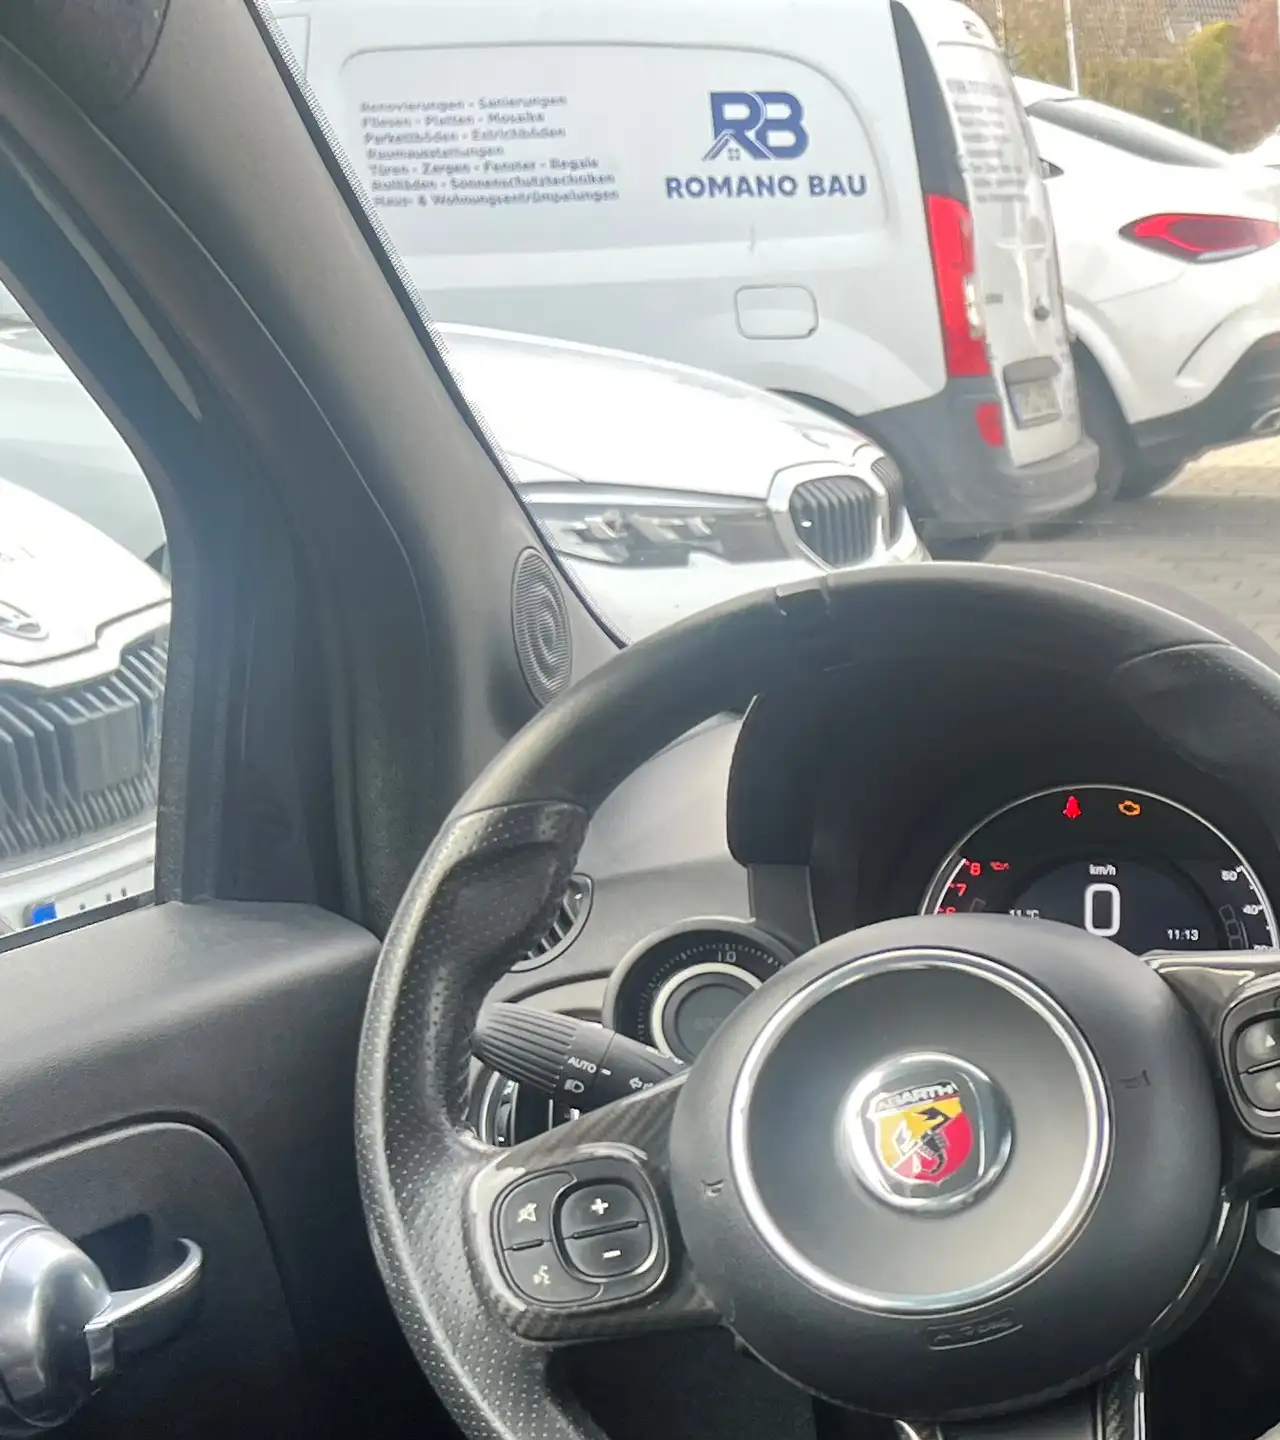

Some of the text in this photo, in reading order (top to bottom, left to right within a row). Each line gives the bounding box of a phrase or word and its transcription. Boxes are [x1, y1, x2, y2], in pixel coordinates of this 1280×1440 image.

[702, 91, 809, 160] RB
[665, 175, 867, 200] ROMANO BAU
[970, 862, 981, 876] 8
[1088, 863, 1117, 876] km/h
[1221, 869, 1238, 881] 50
[957, 883, 967, 896] 7
[1084, 882, 1121, 937] 0
[1243, 904, 1259, 916] 40
[1167, 928, 1199, 941] 11:13
[567, 1054, 597, 1075] AUTO
